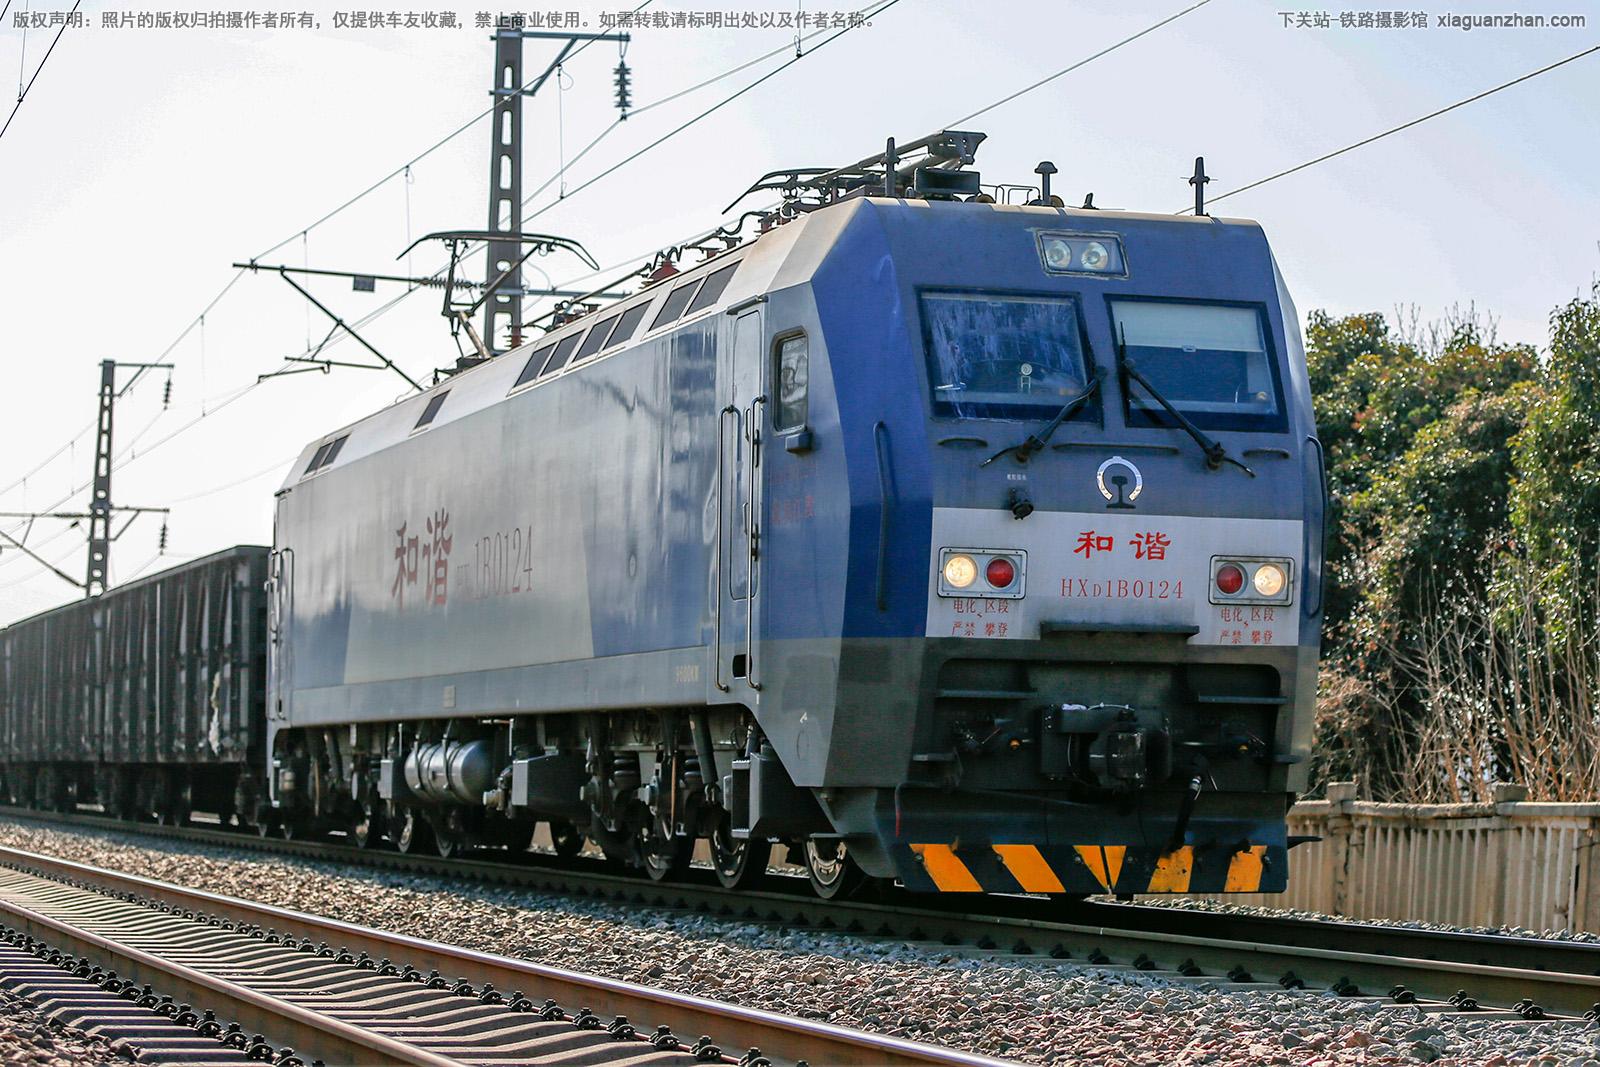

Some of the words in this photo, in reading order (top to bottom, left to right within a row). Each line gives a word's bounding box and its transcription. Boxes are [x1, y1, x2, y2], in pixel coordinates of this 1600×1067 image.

[392, 507, 453, 613] 和谐
[1073, 530, 1171, 560] 和谐
[1061, 578, 1183, 599] HXD1B0124
